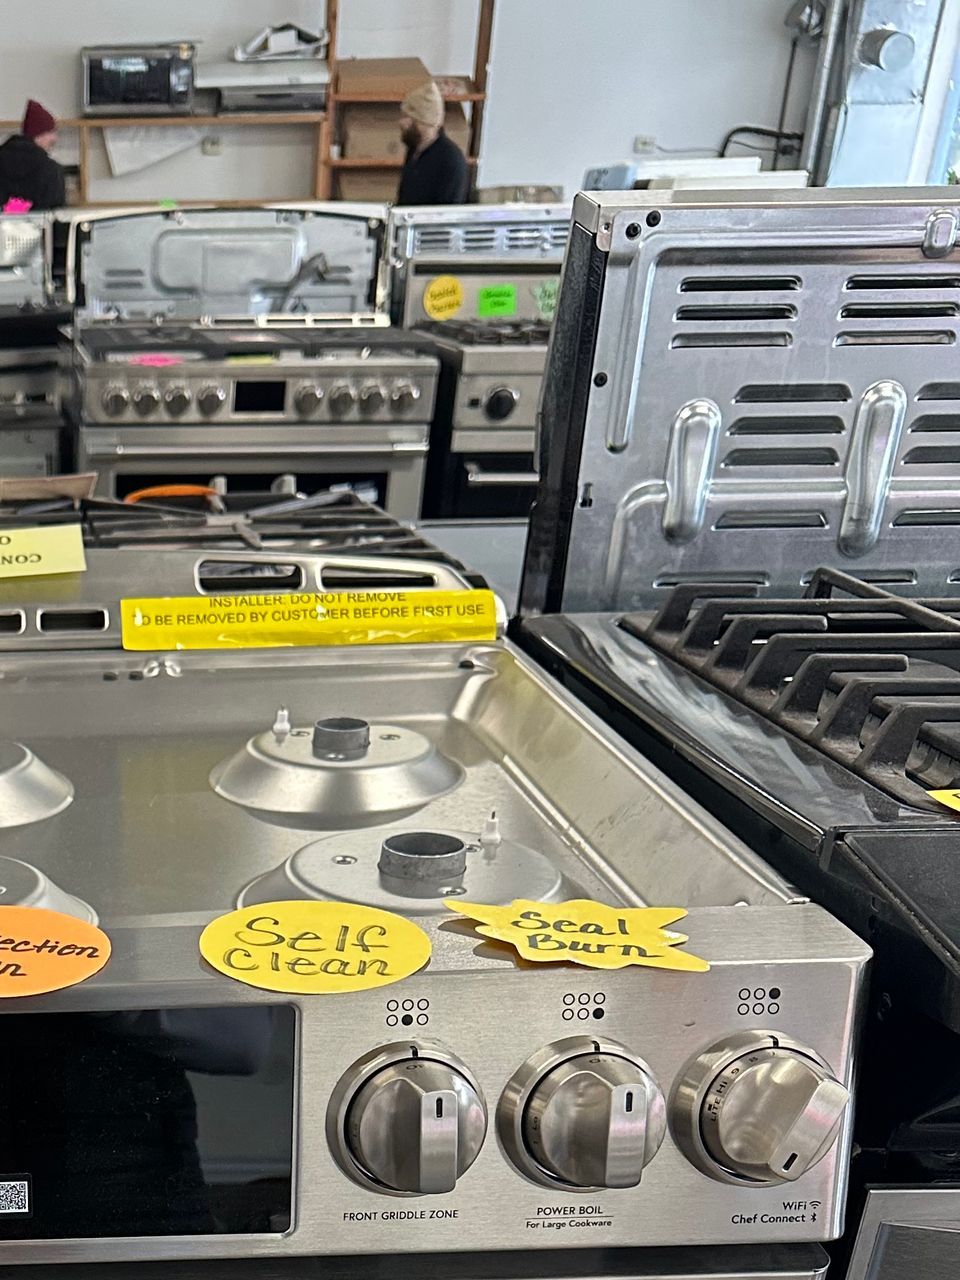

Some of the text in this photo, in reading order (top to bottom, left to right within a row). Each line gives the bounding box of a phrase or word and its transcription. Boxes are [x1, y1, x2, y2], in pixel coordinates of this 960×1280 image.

[290, 594, 311, 605] DO
[314, 593, 341, 604] NOT
[347, 592, 406, 603] REMOVE
[155, 614, 172, 626] BE
[177, 613, 246, 625] REMOVED
[249, 611, 267, 623] BY
[353, 607, 409, 619] BEFORE
[413, 605, 453, 617] FIRST
[455, 604, 485, 616] USE
[511, 911, 630, 936] Seal
[234, 916, 390, 953] Self
[526, 933, 664, 958] Burn
[536, 1206, 604, 1216] POWER BOIL
[782, 1201, 807, 1210] WiFi
[343, 1210, 460, 1221] FRONT GRIDDLE ZONE
[731, 1213, 806, 1224] Chef Connect
[525, 1220, 612, 1230] For Large Cookware
